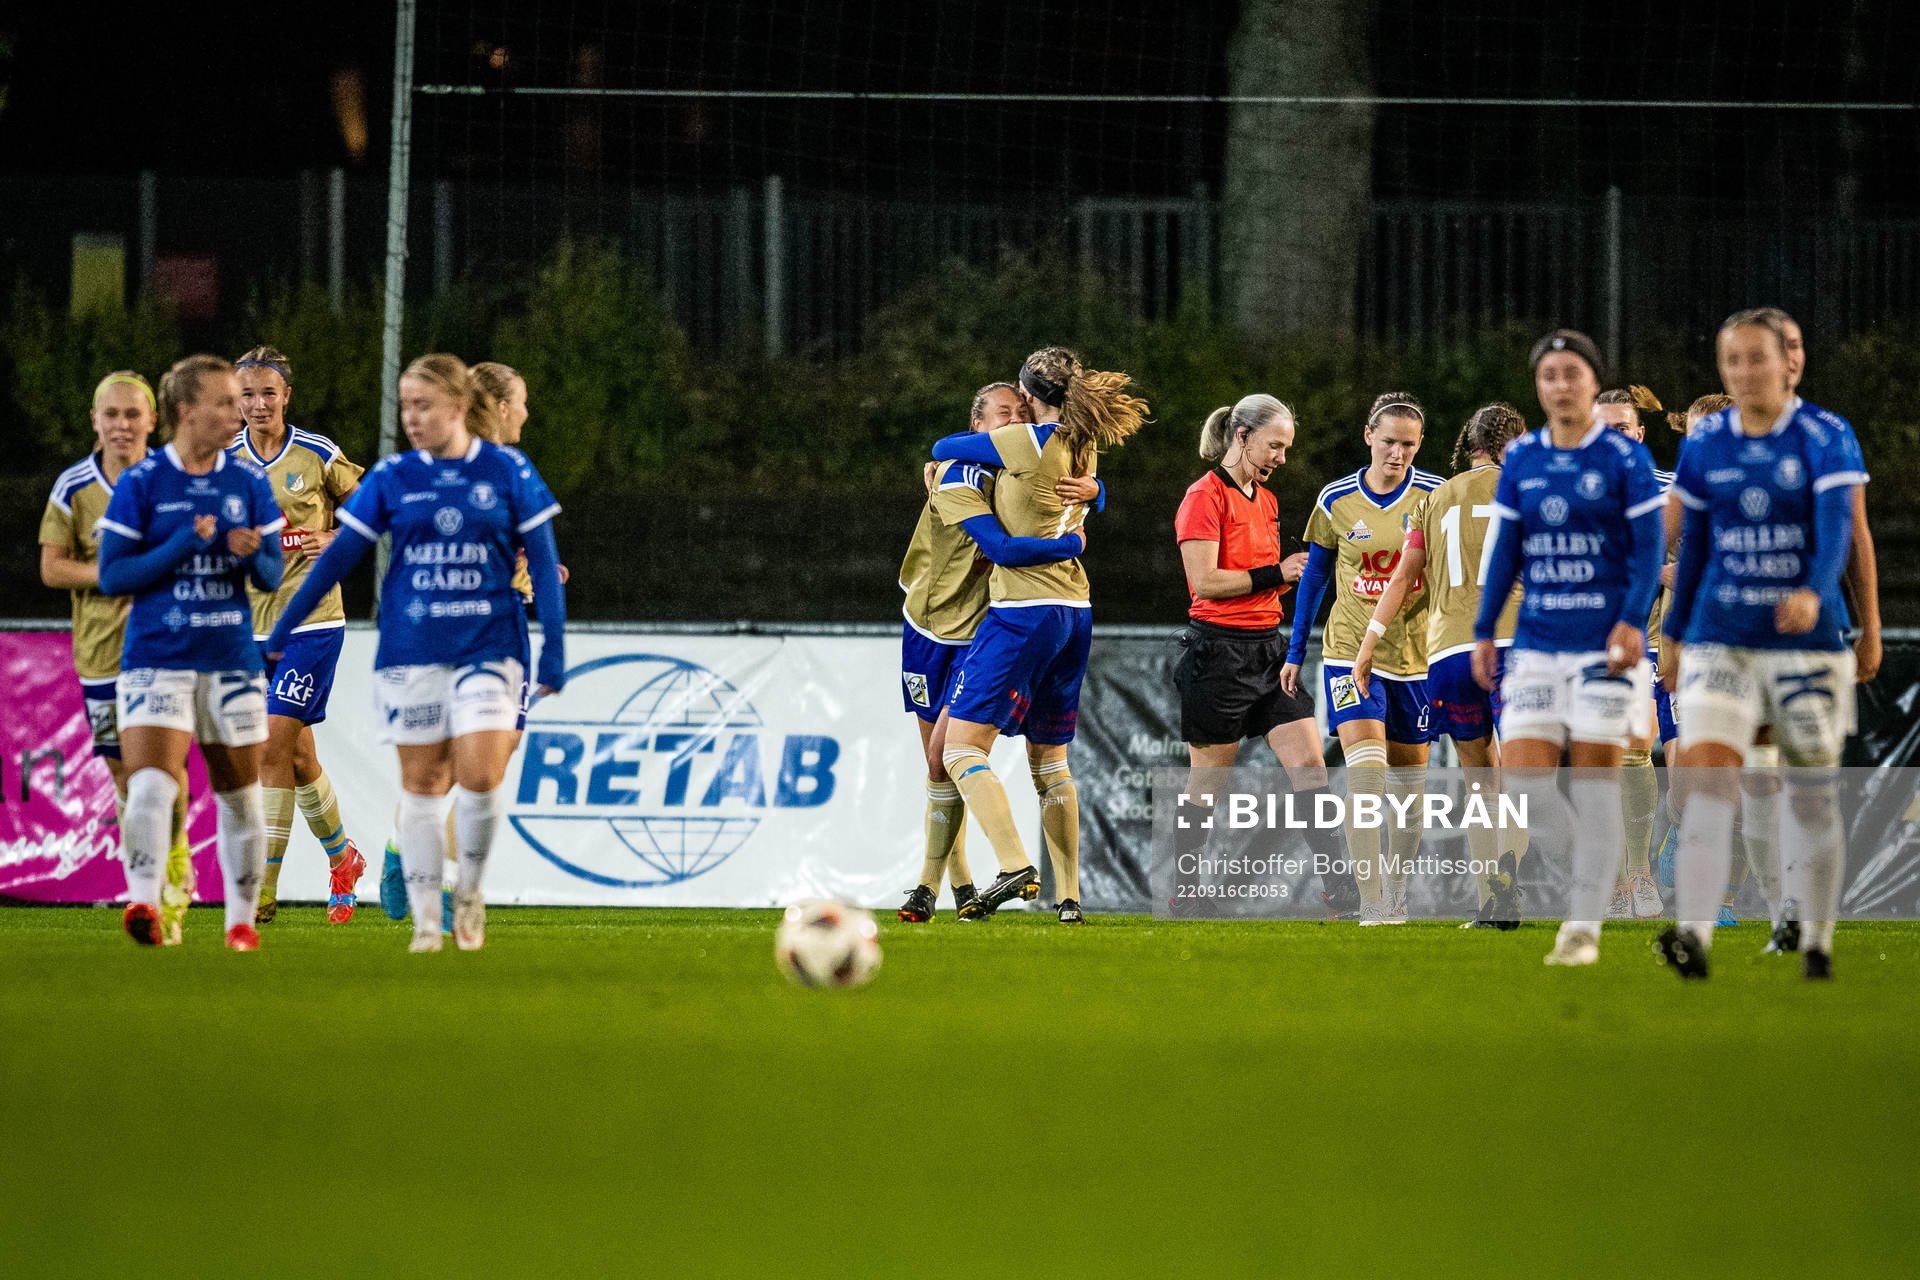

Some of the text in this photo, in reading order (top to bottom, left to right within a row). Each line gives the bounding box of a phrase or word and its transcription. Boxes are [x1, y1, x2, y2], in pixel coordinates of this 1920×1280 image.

[404, 542, 490, 565] MELLBY
[1441, 504, 1501, 587] 17
[173, 577, 234, 601] GÅRD
[412, 565, 482, 591] GÅRD
[275, 679, 314, 702] LKF
[1128, 733, 1189, 756] Malm
[516, 732, 841, 809] RETAB
